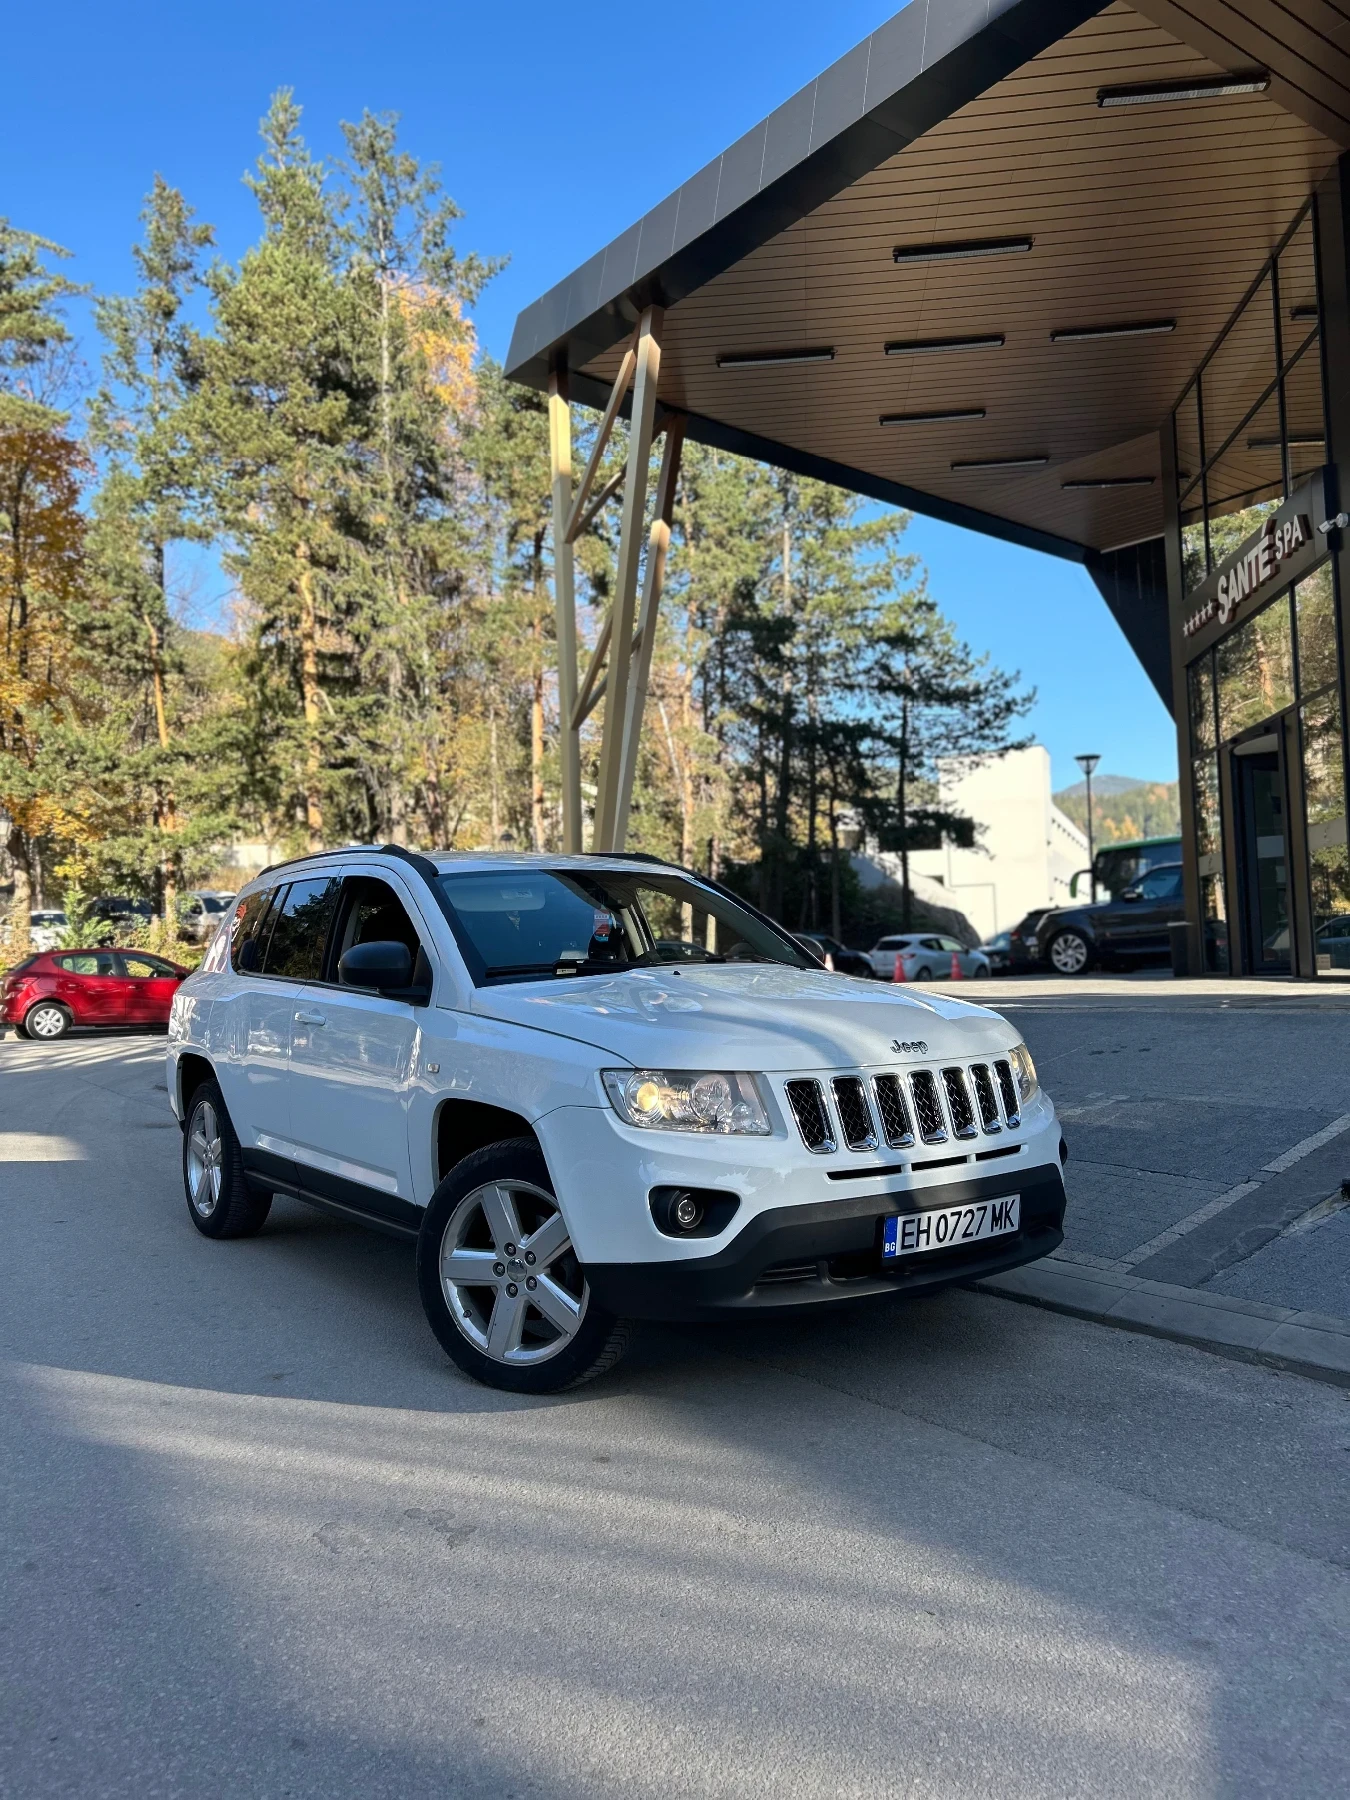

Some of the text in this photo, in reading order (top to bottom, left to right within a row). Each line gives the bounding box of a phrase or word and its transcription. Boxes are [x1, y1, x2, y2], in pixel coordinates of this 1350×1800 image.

[1275, 515, 1303, 560] SPA
[890, 1039, 929, 1055] Jeep
[884, 1241, 896, 1253] BG
